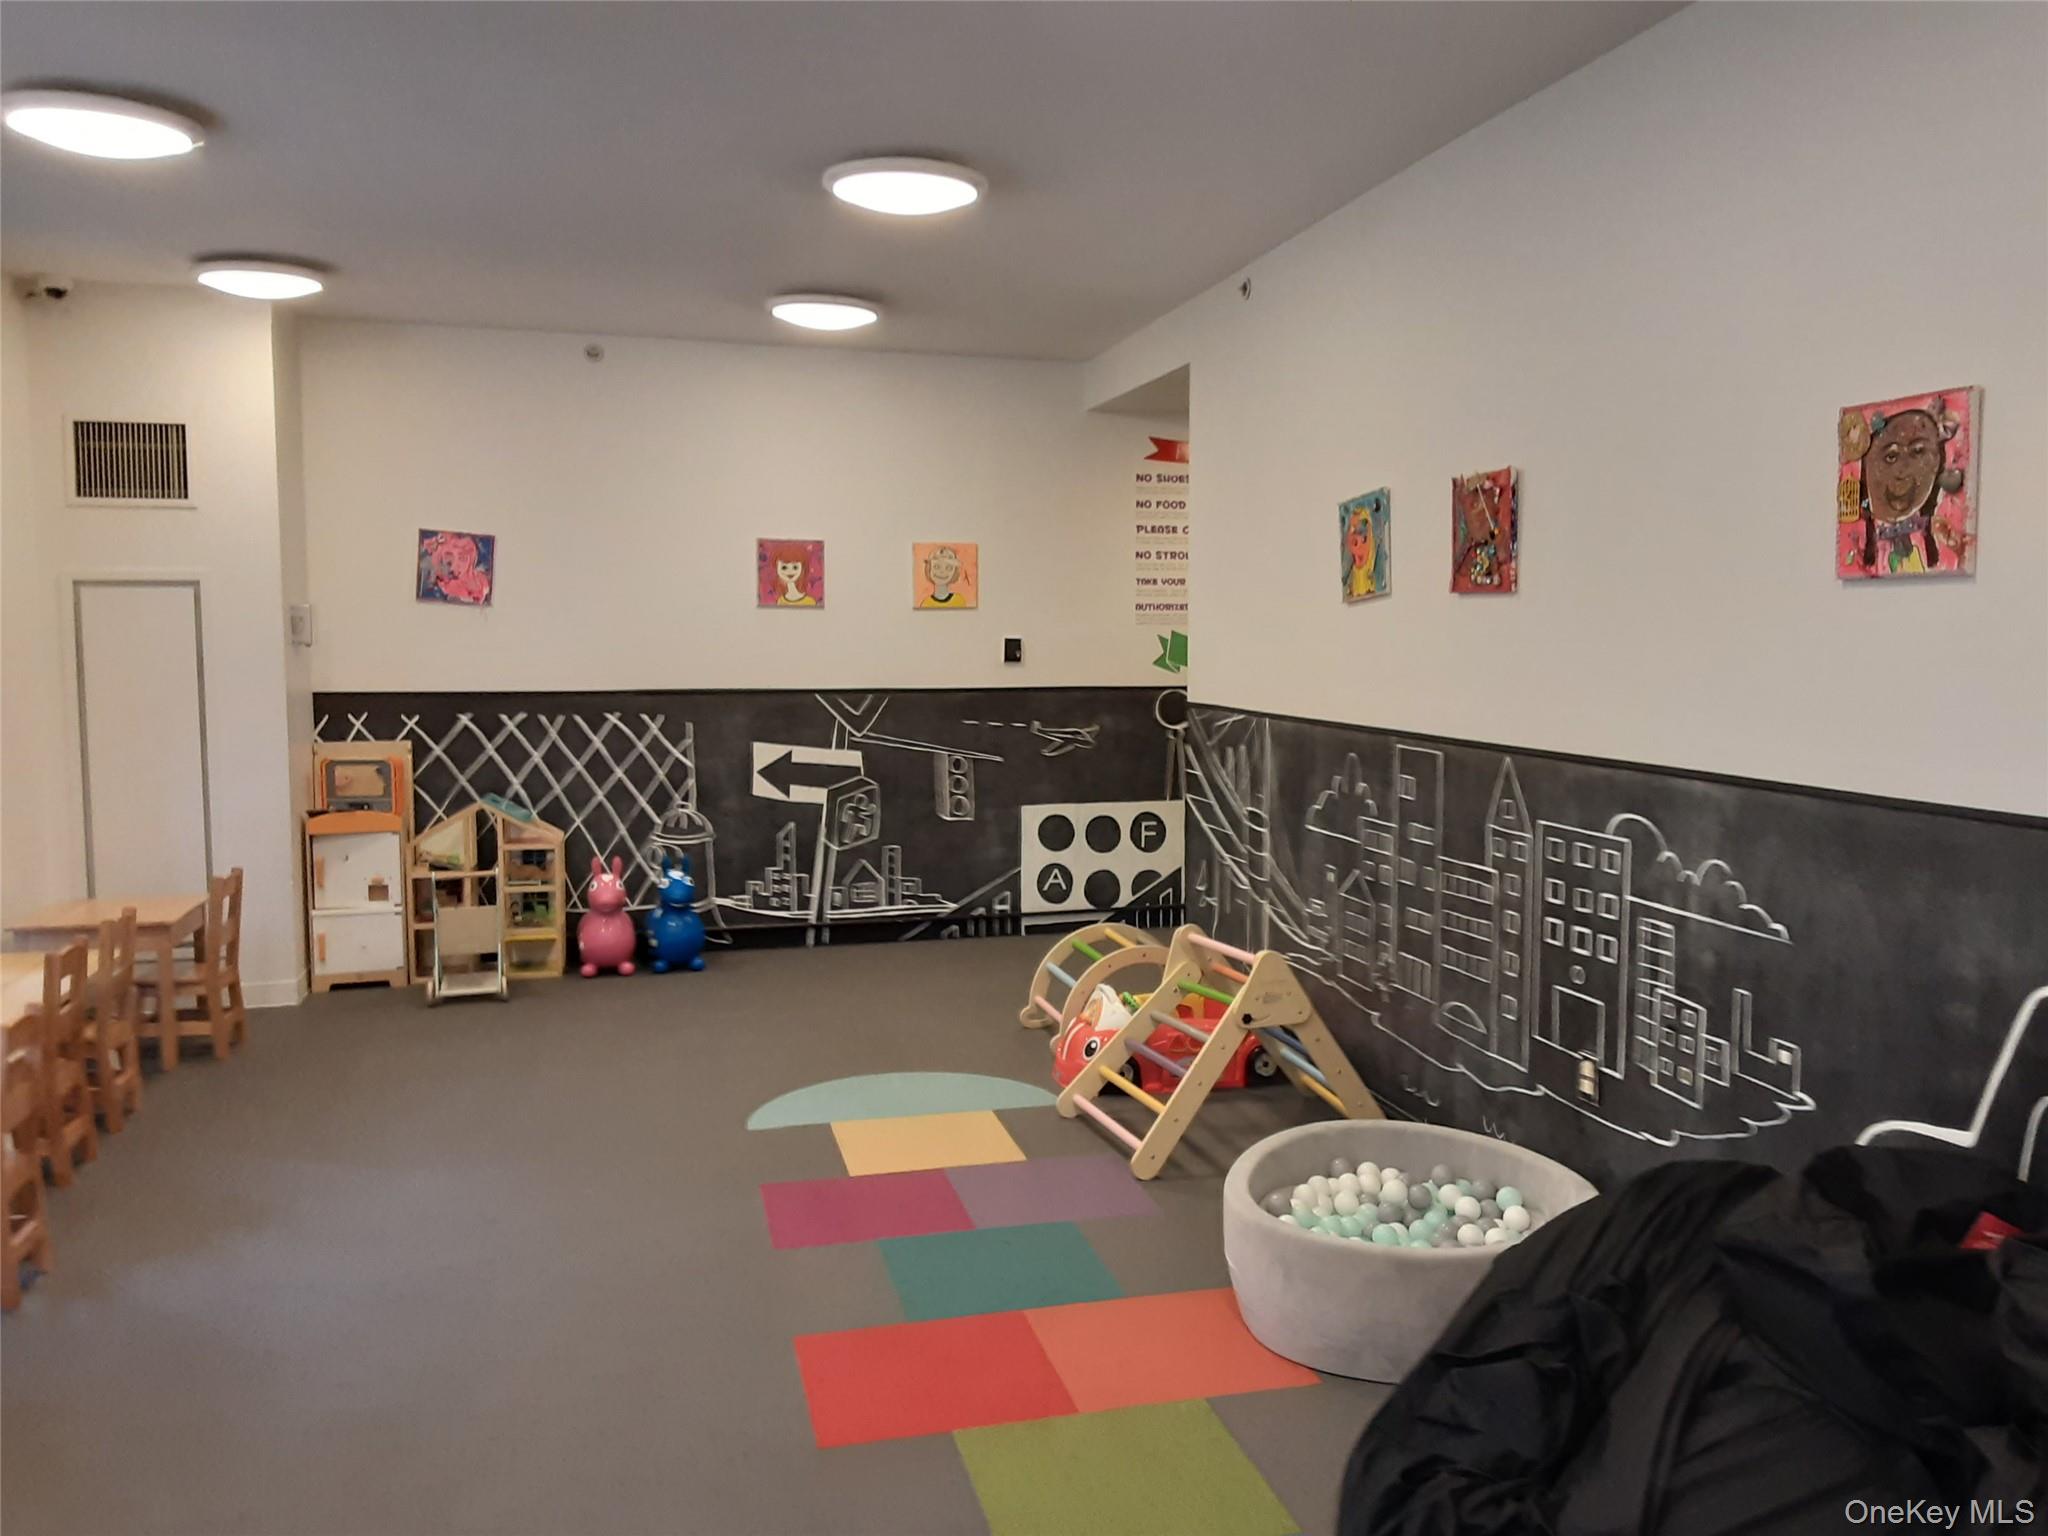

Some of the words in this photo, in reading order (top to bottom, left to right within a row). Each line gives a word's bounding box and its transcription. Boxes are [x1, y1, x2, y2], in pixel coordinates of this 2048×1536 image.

[1136, 473, 1152, 483] NO
[1135, 500, 1152, 509] NO
[1156, 500, 1186, 510] FOOD
[1136, 524, 1178, 534] PLEASE
[1135, 551, 1152, 560] NO
[1140, 821, 1158, 849] F
[1042, 868, 1067, 892] A
